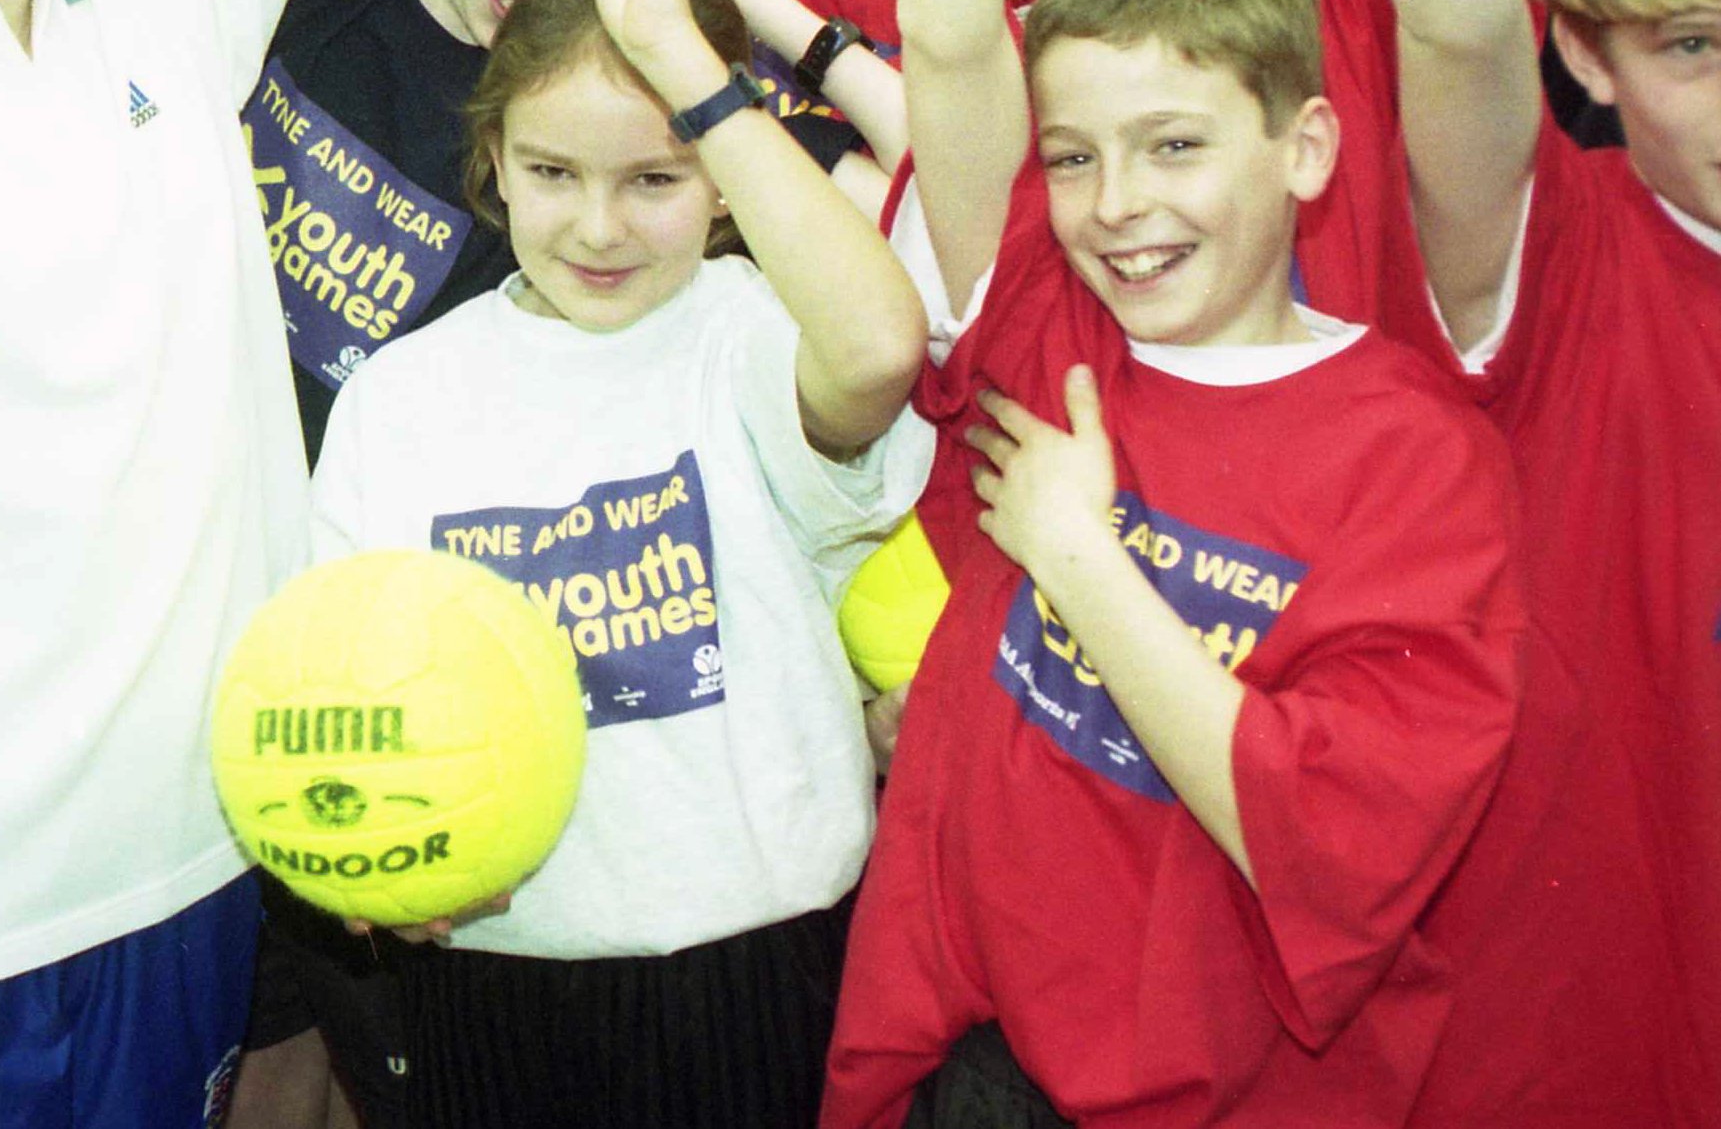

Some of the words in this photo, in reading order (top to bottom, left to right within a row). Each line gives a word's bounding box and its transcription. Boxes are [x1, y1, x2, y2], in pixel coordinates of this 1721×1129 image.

[260, 77, 312, 145] TYNE
[306, 137, 374, 195] AND
[375, 180, 452, 251] WEAR
[269, 186, 415, 311] youth
[443, 523, 522, 556] TYNE
[532, 505, 594, 554] AND
[603, 474, 690, 531] WEAR
[528, 533, 707, 619] youth
[556, 587, 716, 659] ames
[255, 706, 402, 756] PUMA
[259, 831, 450, 879] INDOOR
